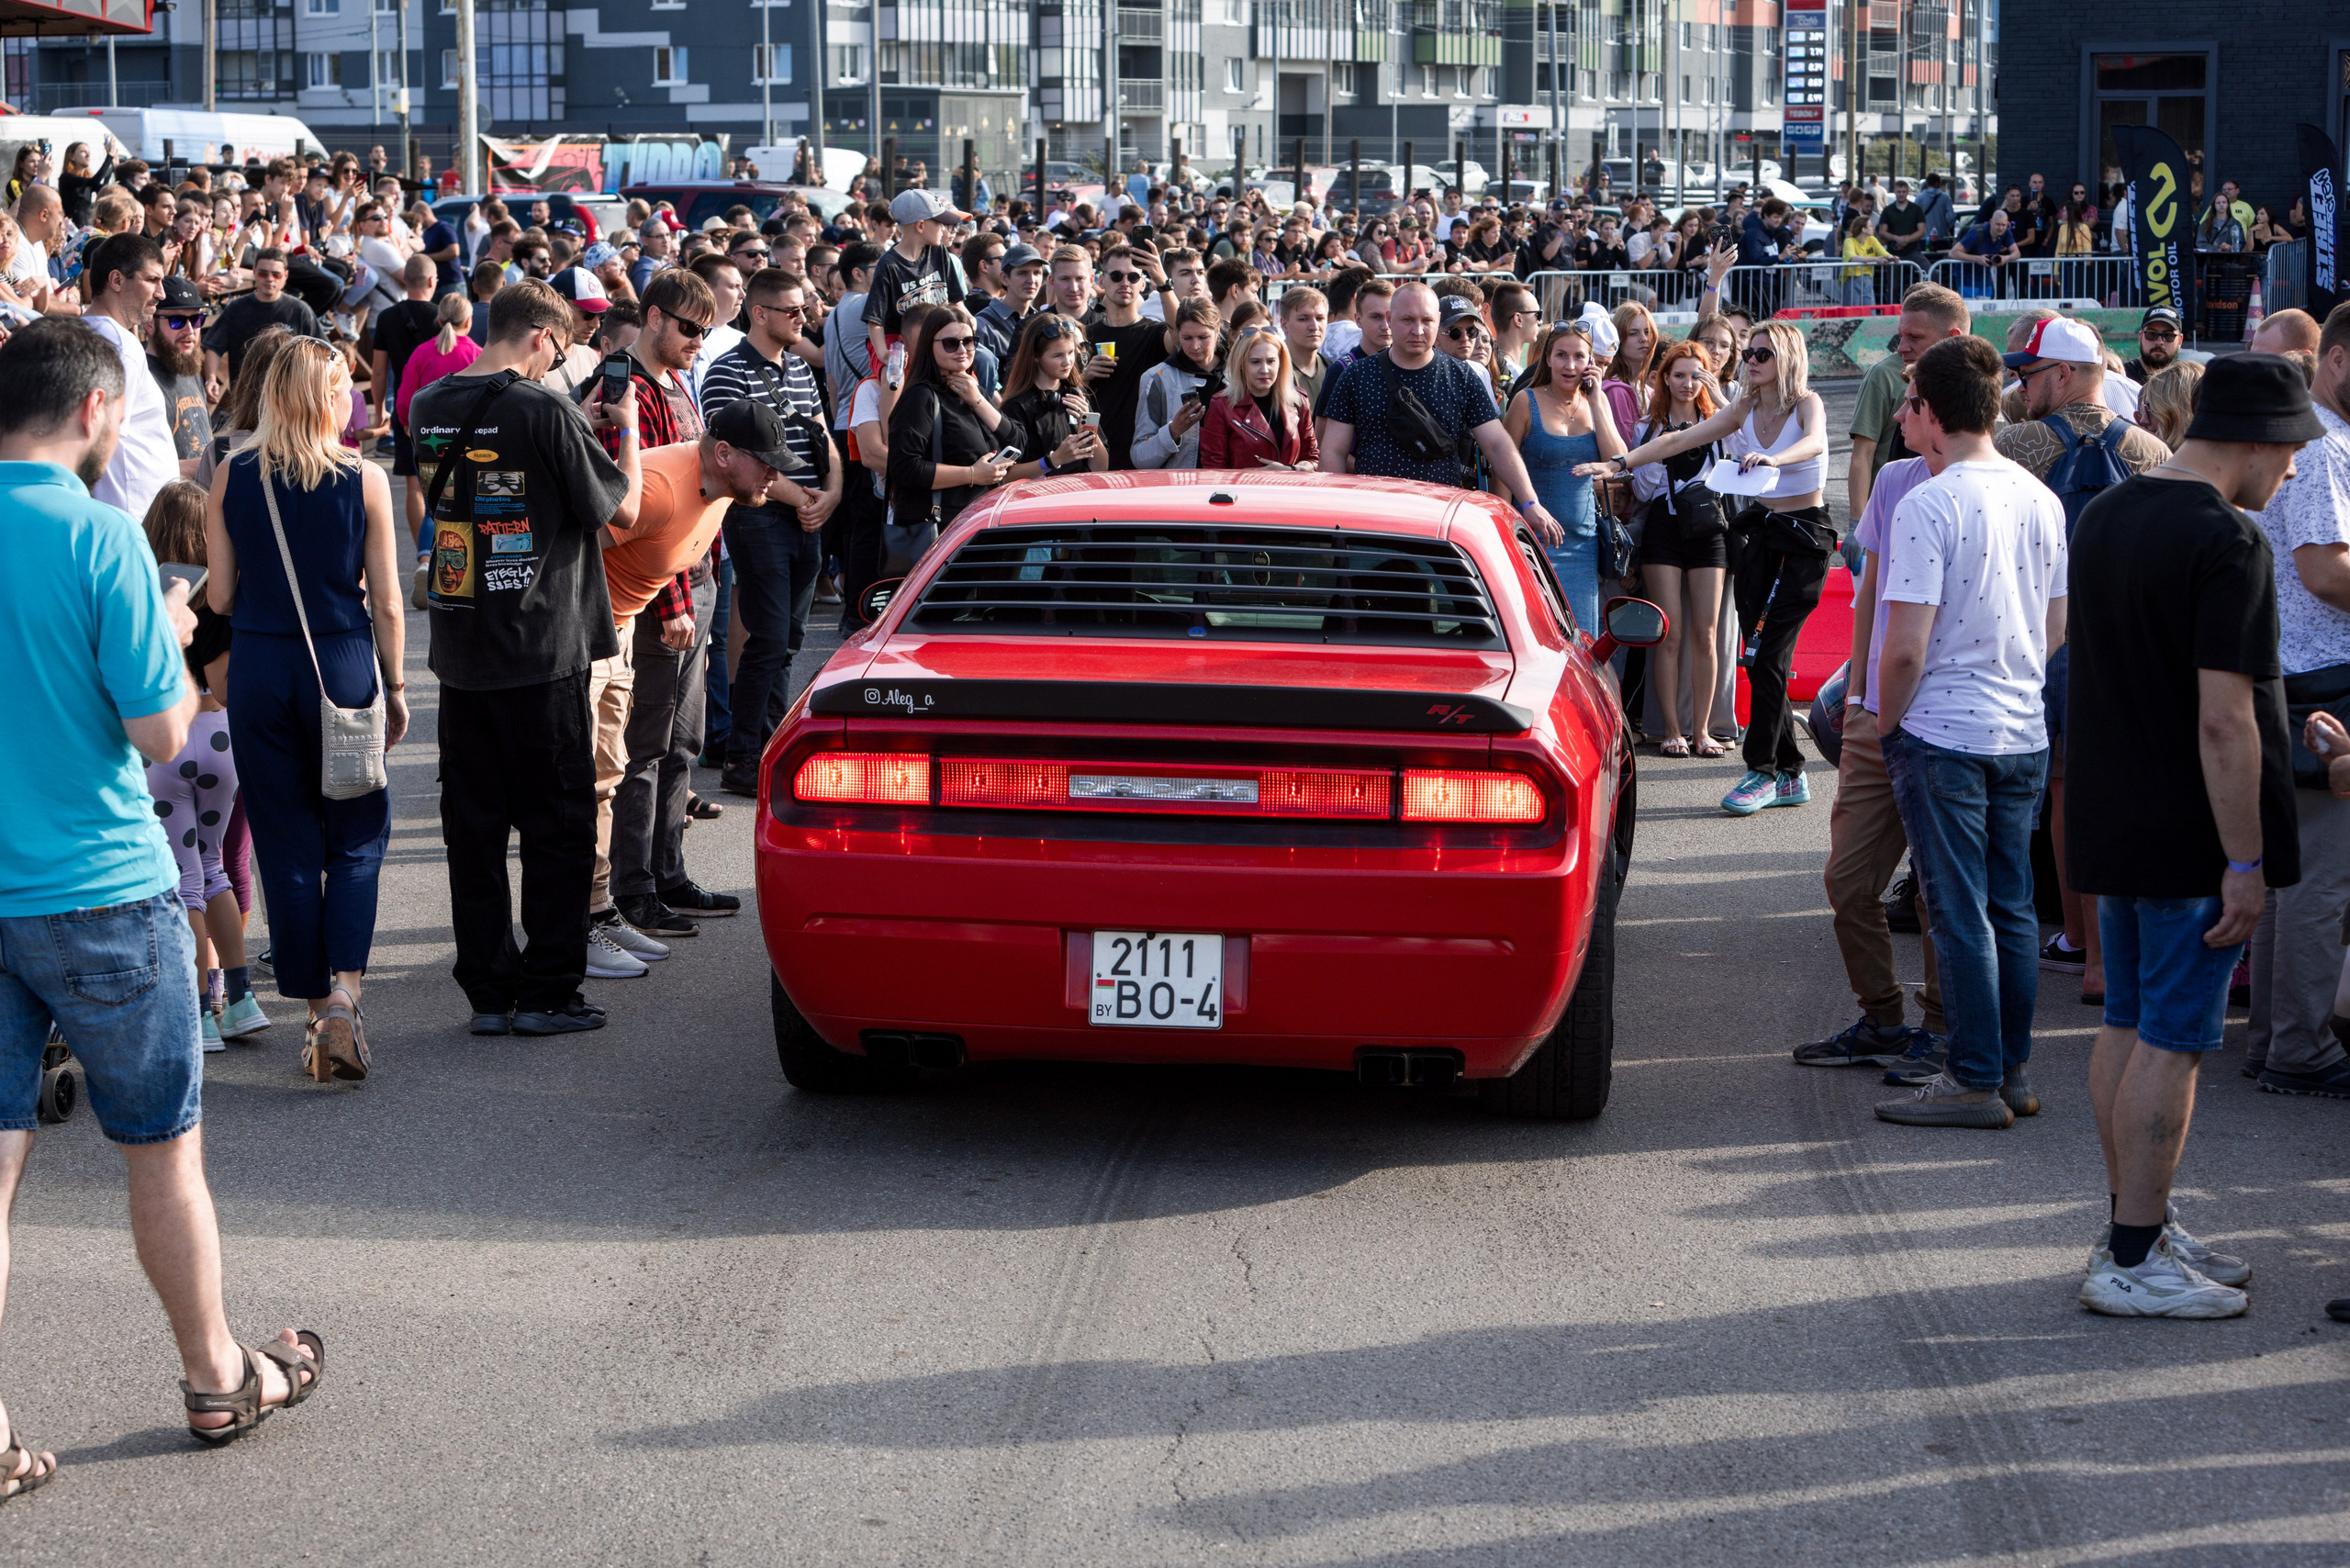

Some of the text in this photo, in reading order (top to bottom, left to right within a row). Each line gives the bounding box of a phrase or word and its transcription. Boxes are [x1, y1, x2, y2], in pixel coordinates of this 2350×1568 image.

[2310, 178, 2329, 289] STREET
[2167, 241, 2178, 265] OIL
[901, 270, 942, 294] US OPEN
[420, 425, 461, 435] Ordinary
[477, 517, 531, 535] PATTERN
[485, 566, 534, 581] EYEGLA
[1426, 704, 1476, 724] R/T
[1111, 937, 1194, 978] 2111
[1096, 980, 1217, 1022] BY BO-4
[2109, 1276, 2132, 1294] FILA
